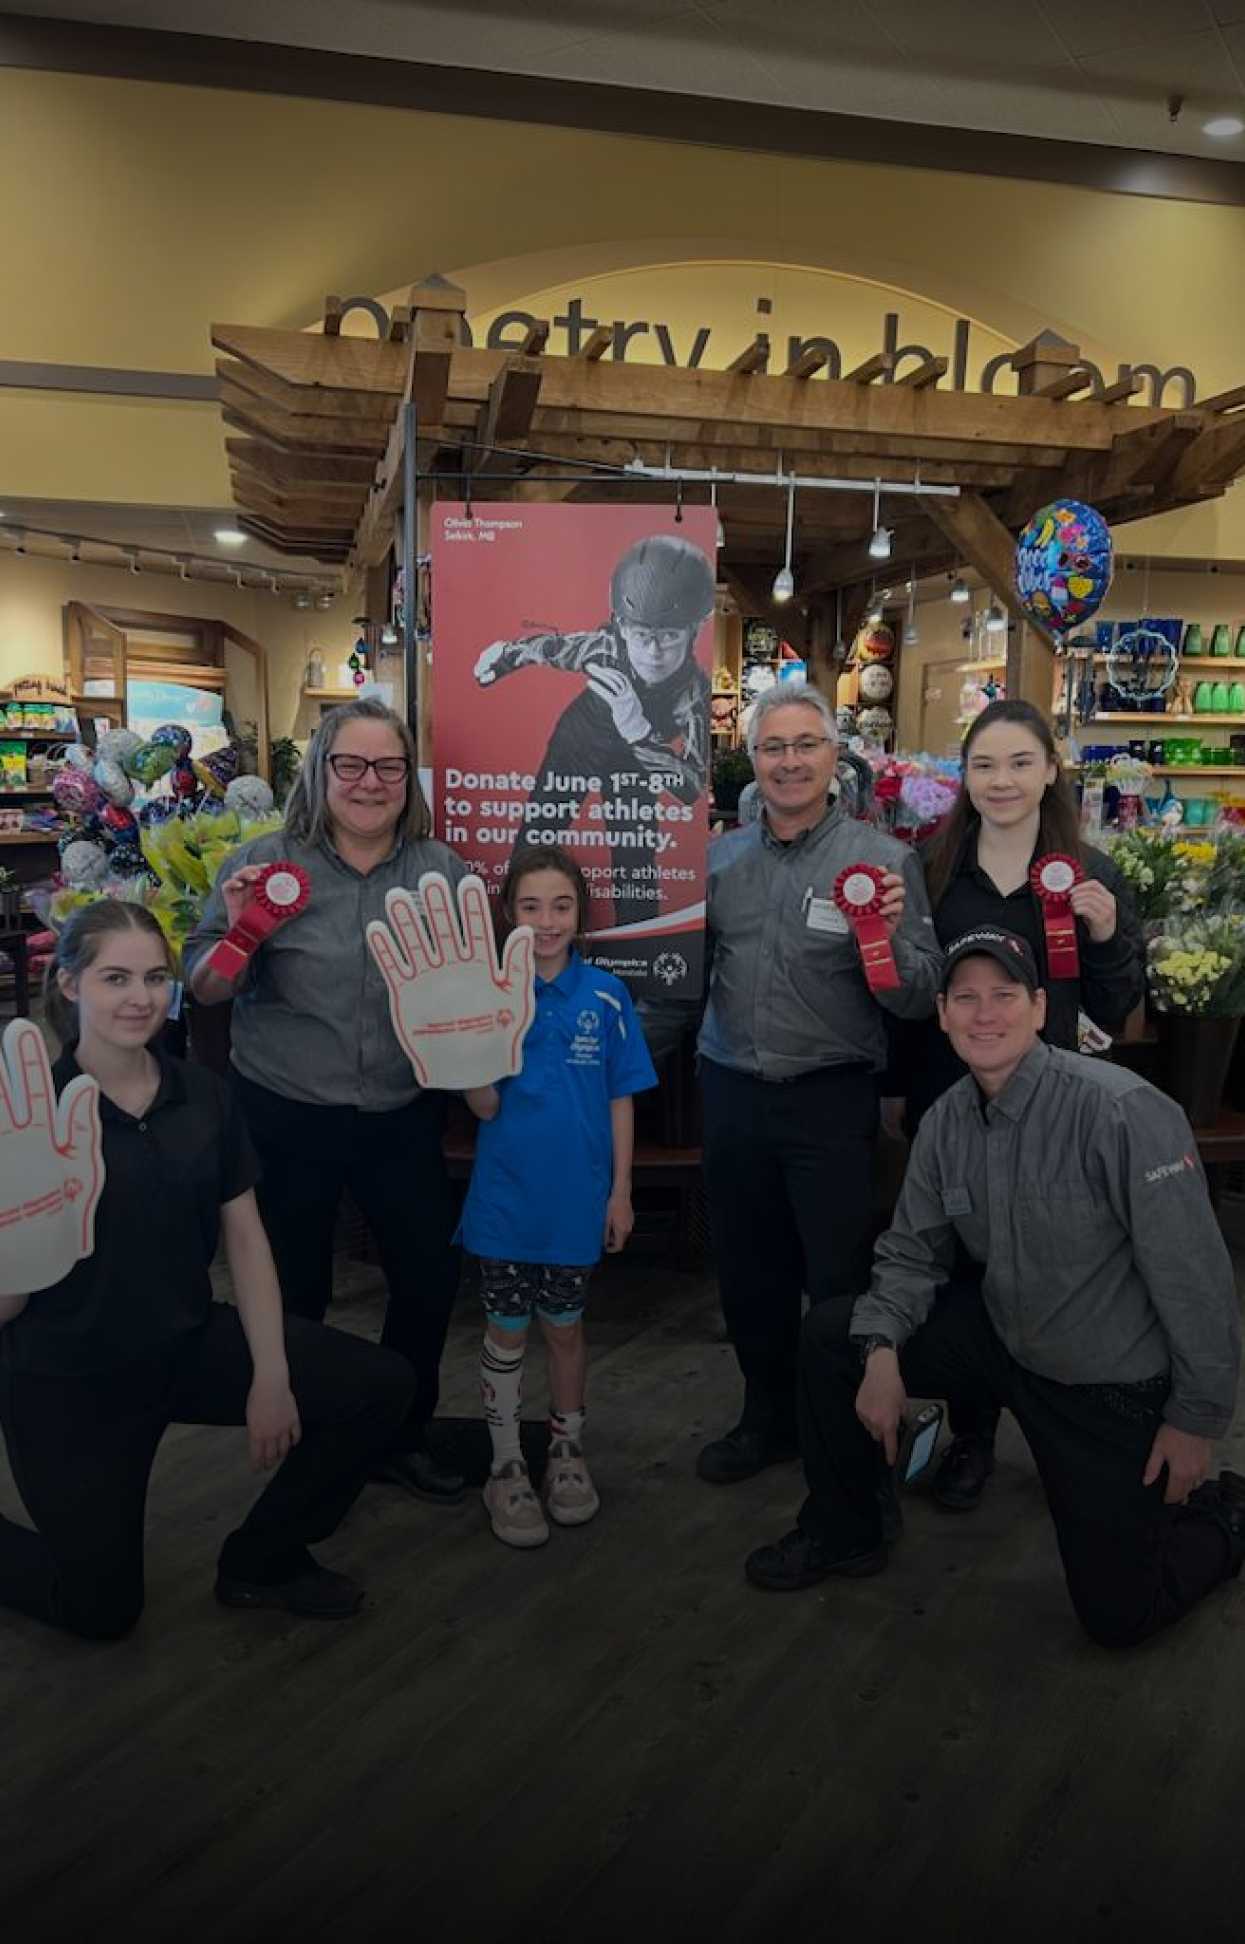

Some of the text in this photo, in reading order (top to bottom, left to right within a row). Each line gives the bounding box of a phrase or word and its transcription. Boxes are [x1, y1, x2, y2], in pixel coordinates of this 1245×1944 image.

[445, 769, 536, 791] Donate
[542, 772, 602, 793] June
[444, 797, 693, 823] to support athletes
[445, 820, 677, 853] in our community.
[631, 864, 697, 881] athletes
[590, 883, 669, 901] isabilities.
